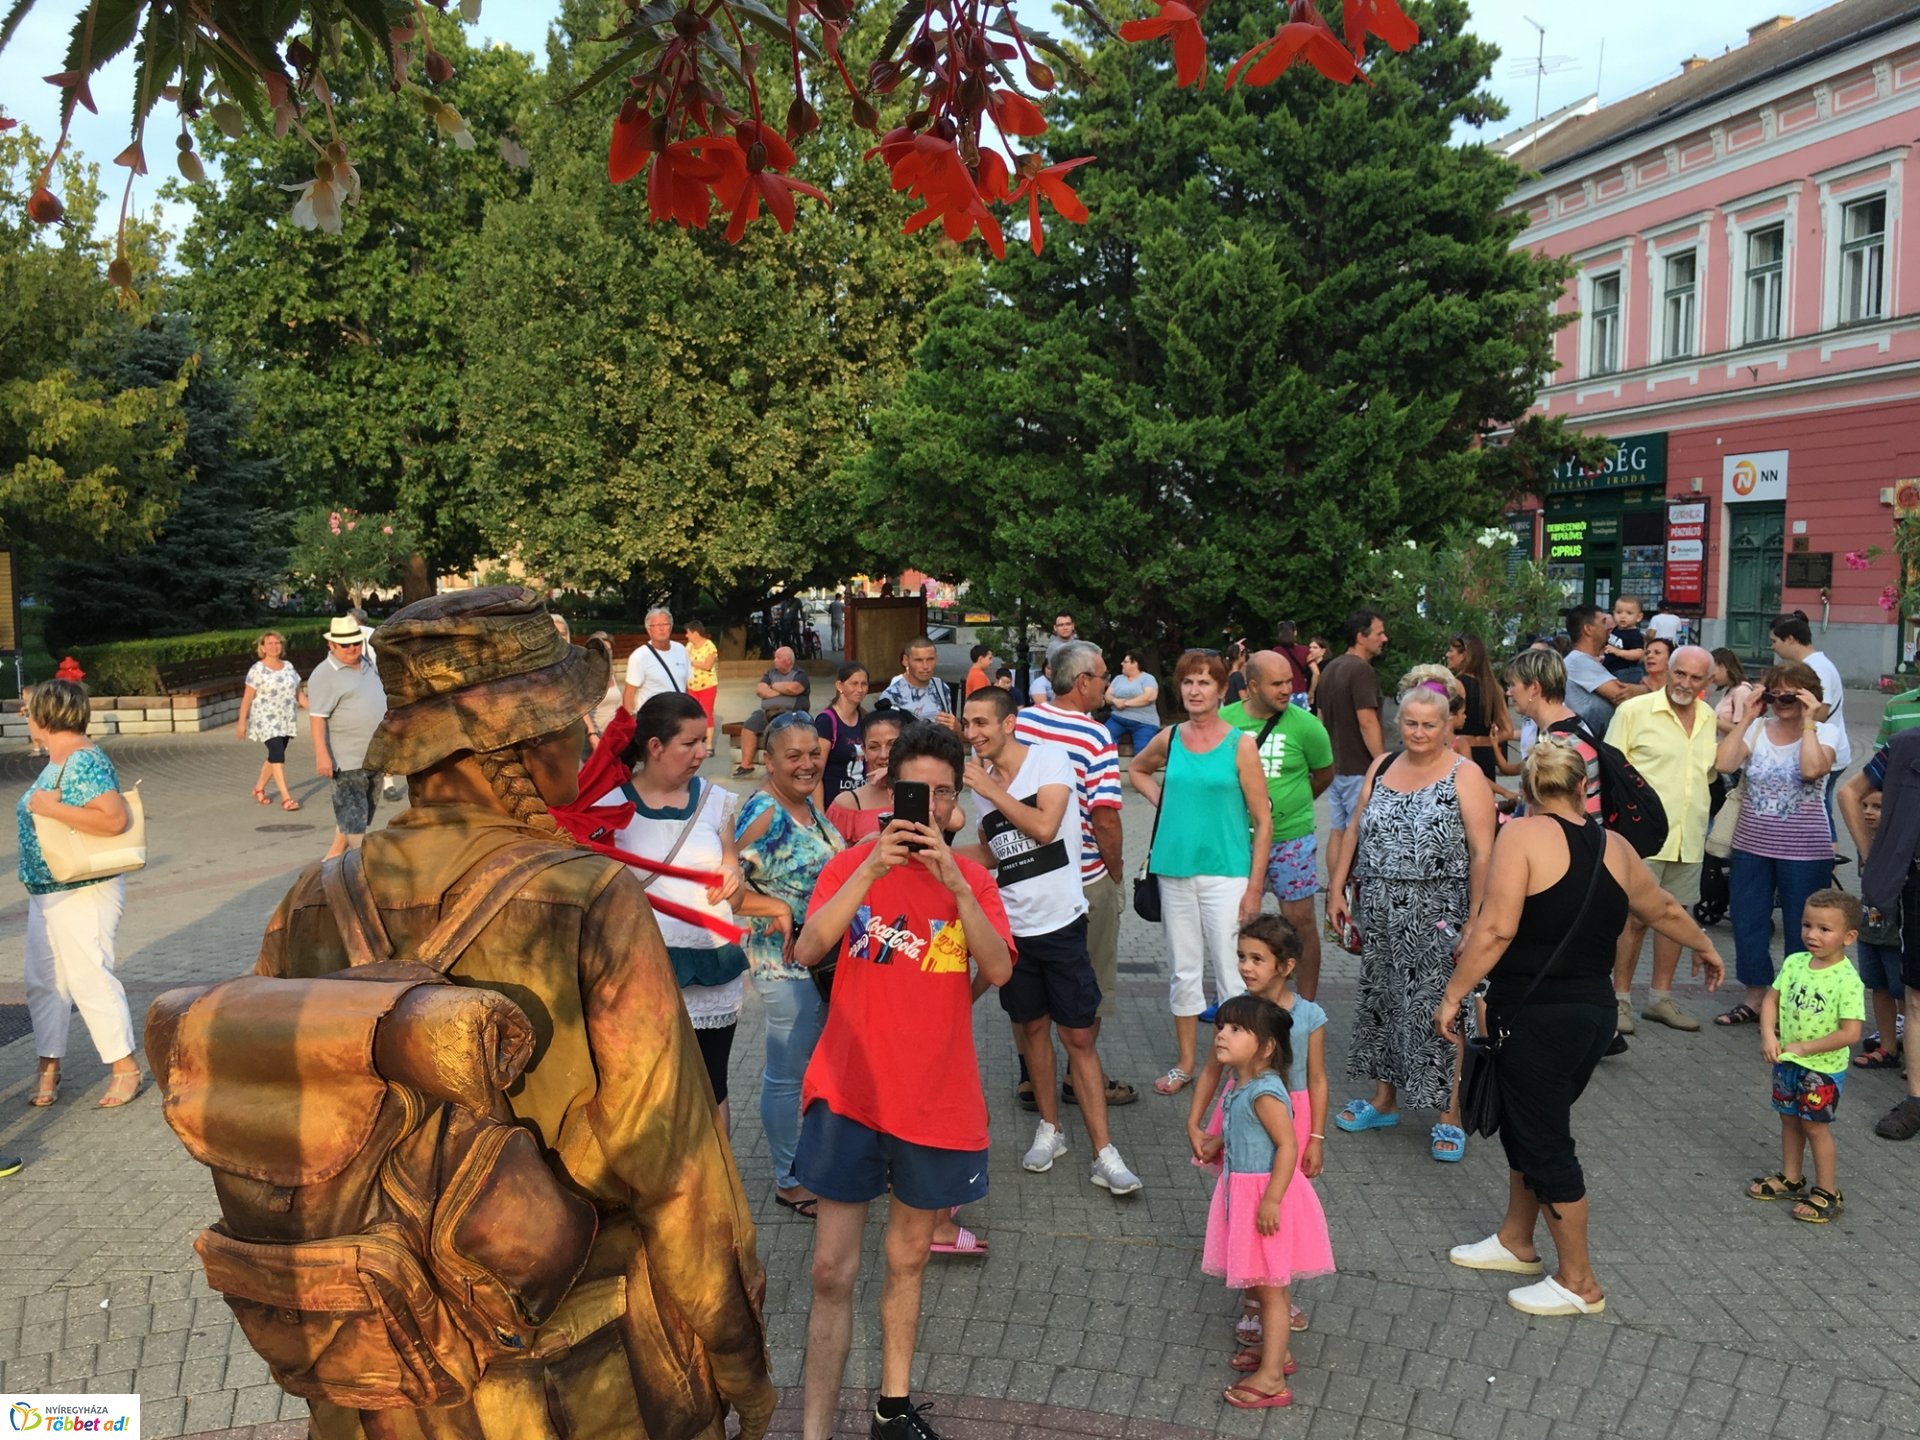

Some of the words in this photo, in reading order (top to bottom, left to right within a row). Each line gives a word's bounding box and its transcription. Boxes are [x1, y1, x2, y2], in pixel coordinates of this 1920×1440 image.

[1552, 442, 1648, 479] YSÉG
[1760, 469, 1778, 482] NN
[1548, 479, 1595, 492] TAZÁSI
[1606, 474, 1646, 485] IRODA
[1551, 545, 1582, 557] CIPRUS
[1019, 857, 1035, 866] WEAR
